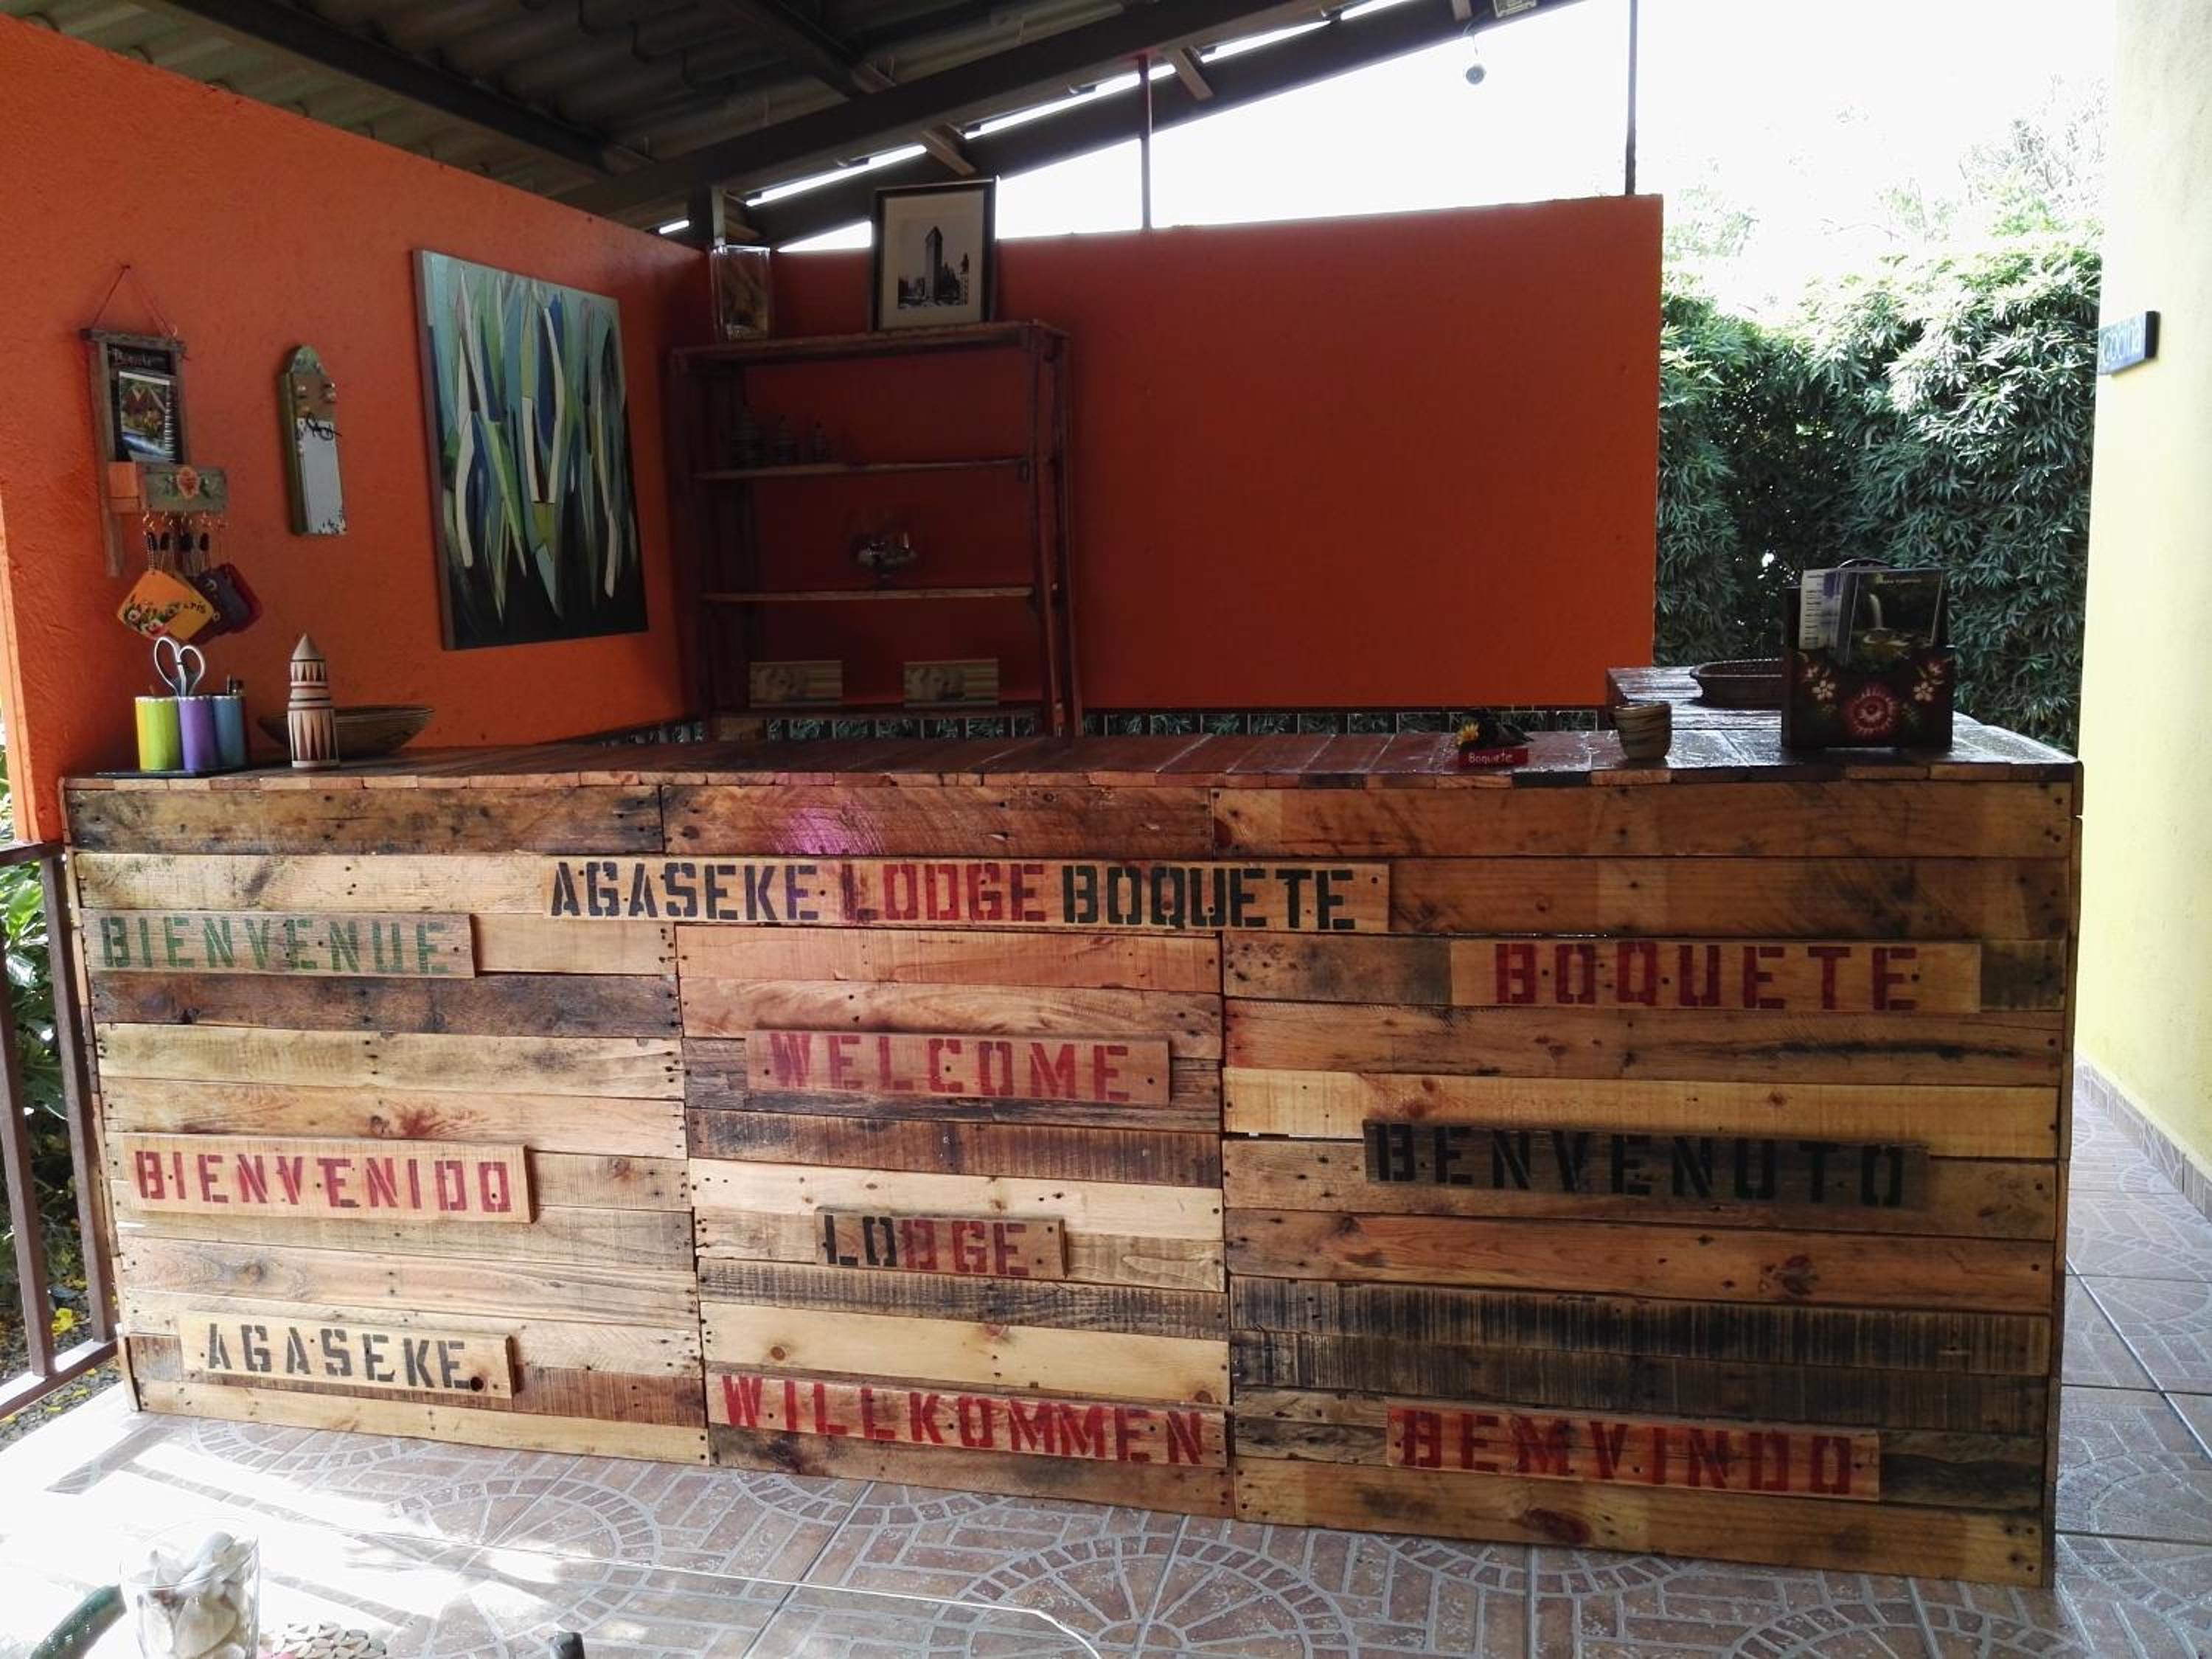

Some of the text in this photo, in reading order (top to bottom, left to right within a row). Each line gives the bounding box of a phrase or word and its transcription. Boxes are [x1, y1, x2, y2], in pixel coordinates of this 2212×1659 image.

[551, 861, 1356, 931] AGASEKE LODGE BOQUETE
[100, 917, 450, 975] BIENVENUE
[1495, 942, 1919, 1011] BOQUETE
[768, 1032, 1130, 1102] WELCOME
[135, 1150, 512, 1214] BIENVENIDO
[1376, 1122, 1904, 1208] BENVENUTO
[824, 1214, 1030, 1276] LODGE
[208, 1322, 475, 1390] AGASEKE
[721, 1374, 1204, 1465] WILLKOMMEN
[1402, 1409, 1853, 1495] BEMVINDO
